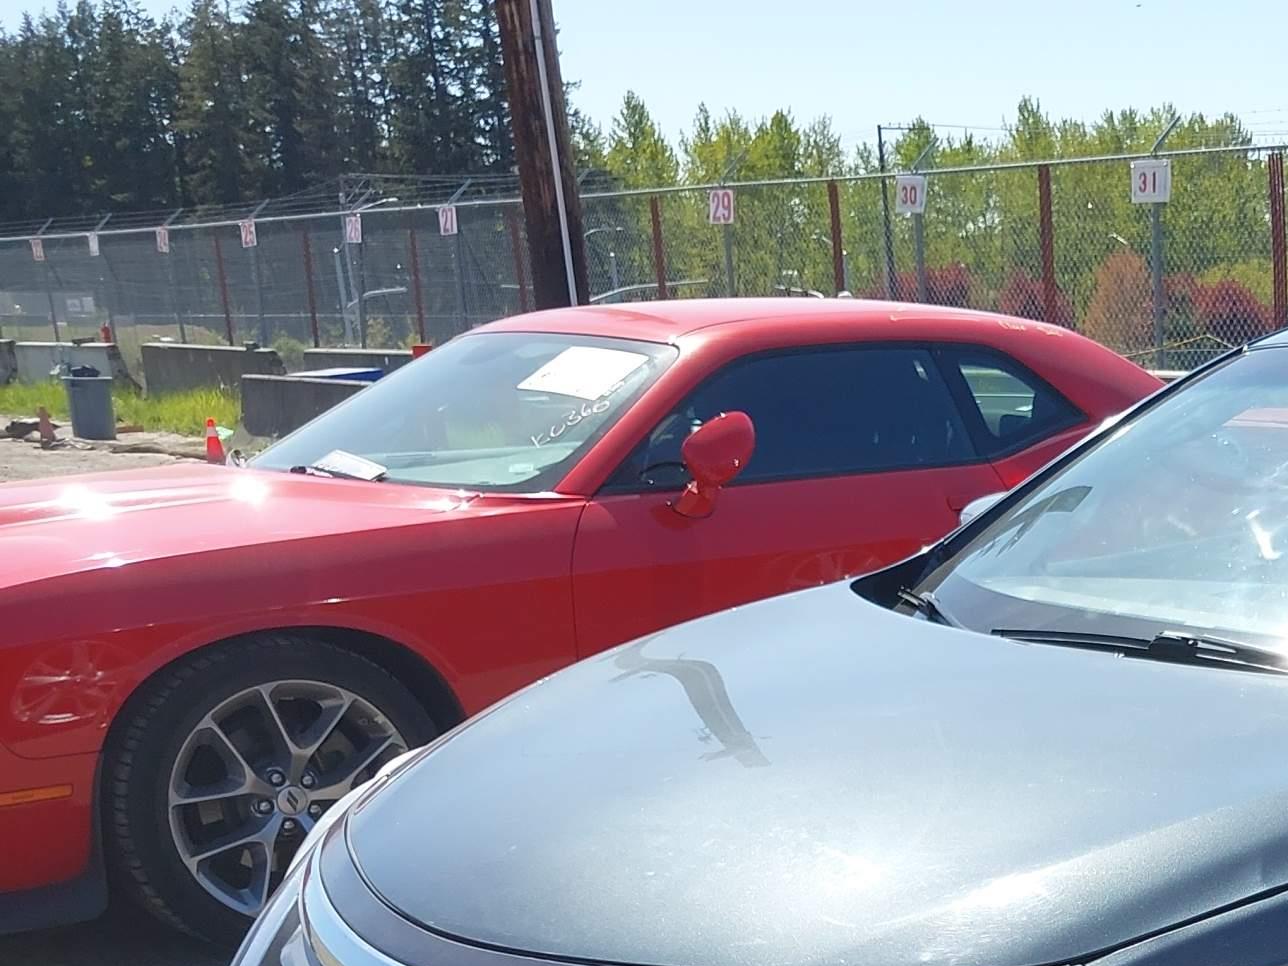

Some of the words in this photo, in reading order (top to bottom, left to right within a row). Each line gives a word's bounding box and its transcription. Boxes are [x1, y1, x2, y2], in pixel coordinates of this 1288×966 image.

[901, 185, 918, 207] 30
[1138, 175, 1158, 195] 31
[712, 192, 732, 223] 29
